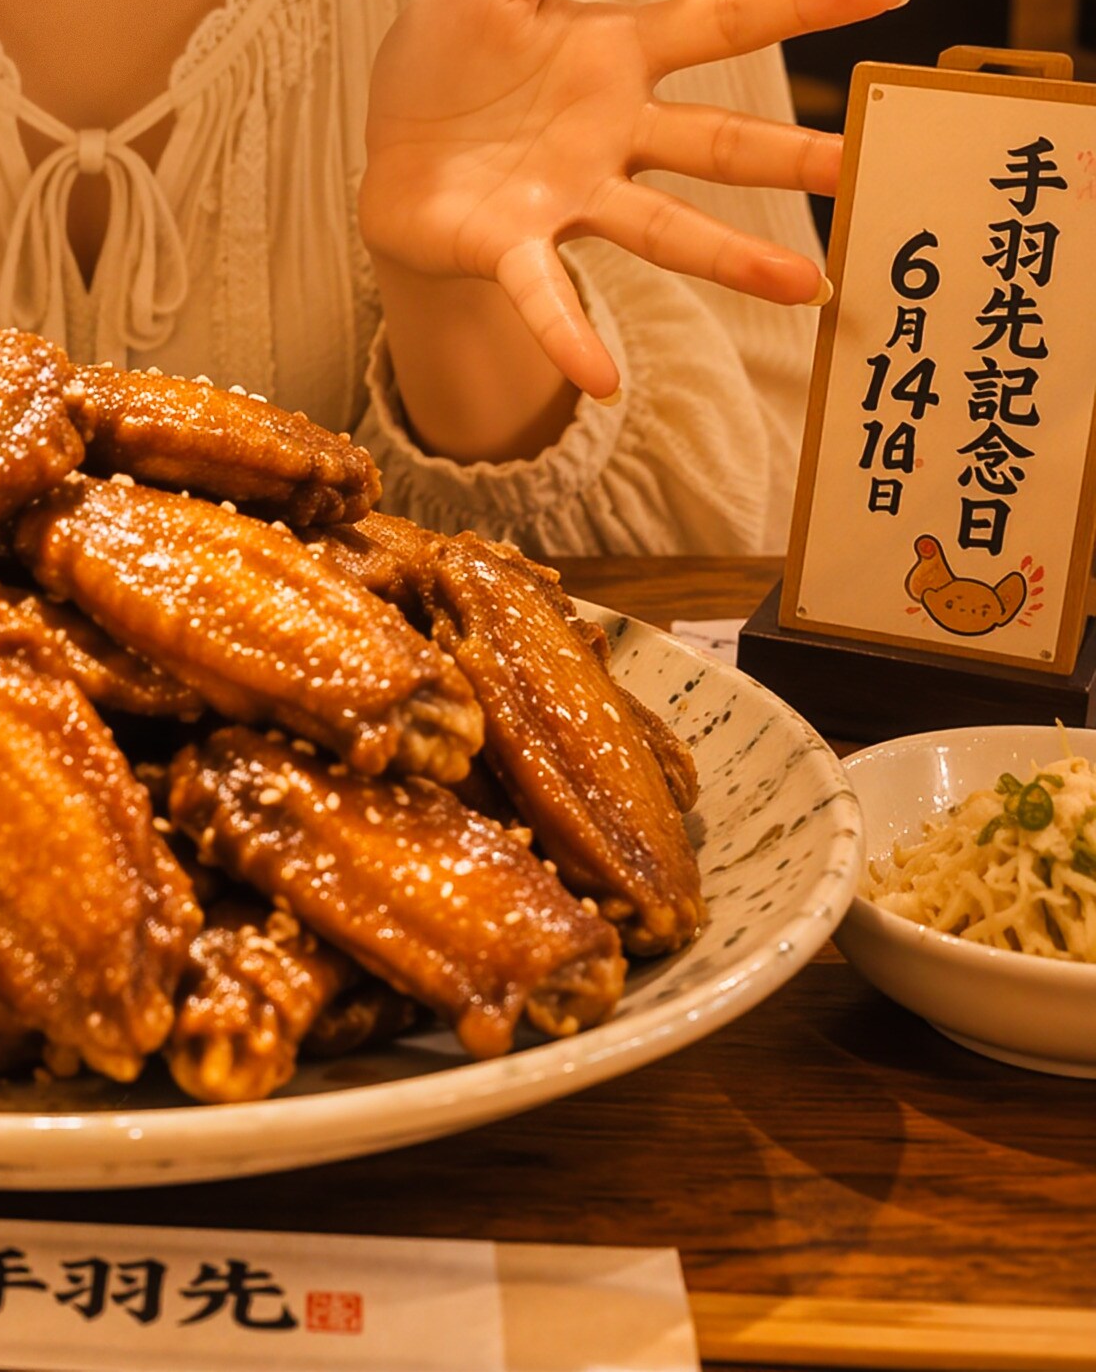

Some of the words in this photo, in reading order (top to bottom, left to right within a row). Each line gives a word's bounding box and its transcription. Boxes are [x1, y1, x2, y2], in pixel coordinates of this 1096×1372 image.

[956, 136, 1068, 556] 手羽先記念日
